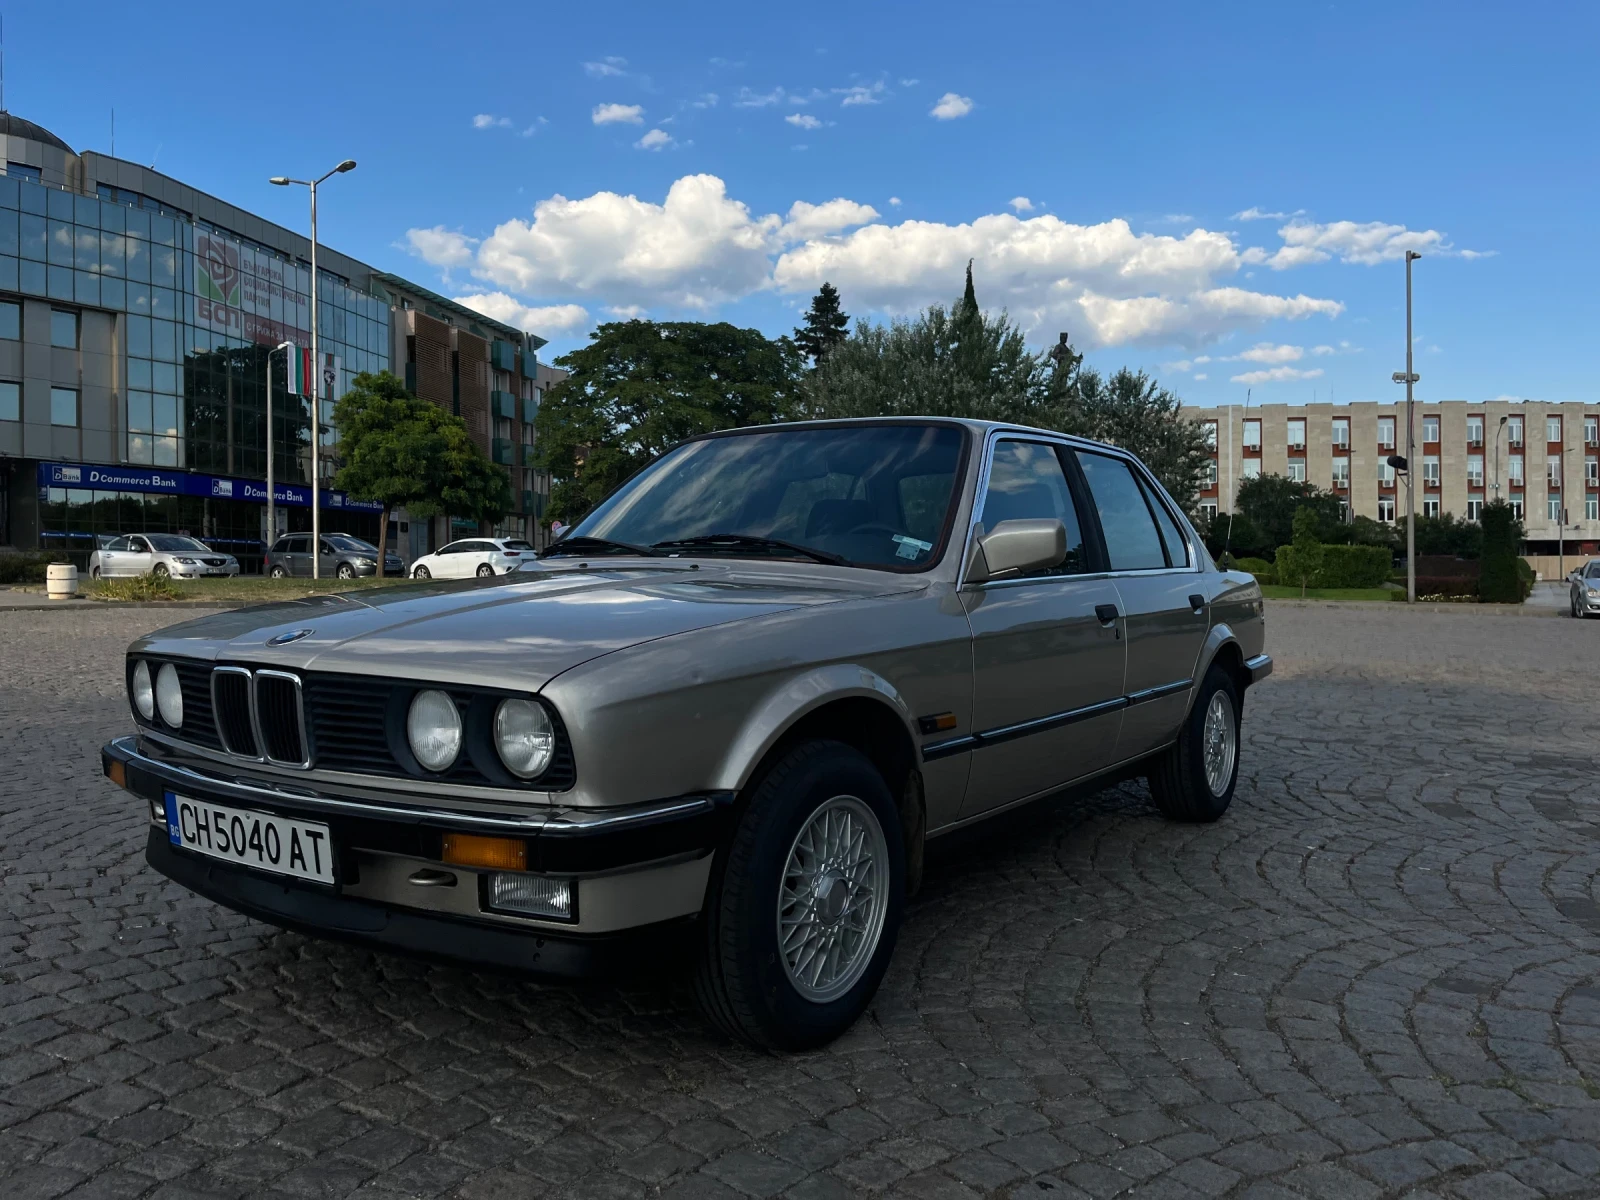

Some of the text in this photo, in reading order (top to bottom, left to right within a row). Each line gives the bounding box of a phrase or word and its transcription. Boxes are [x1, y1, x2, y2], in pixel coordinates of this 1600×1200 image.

[198, 299, 239, 329] БСП
[63, 473, 80, 481] Bank
[90, 471, 176, 487] D Commerce Bank
[219, 486, 232, 494] Bank
[245, 486, 303, 501] D Comerce Bank
[170, 824, 180, 838] BG
[289, 827, 324, 875] AT
